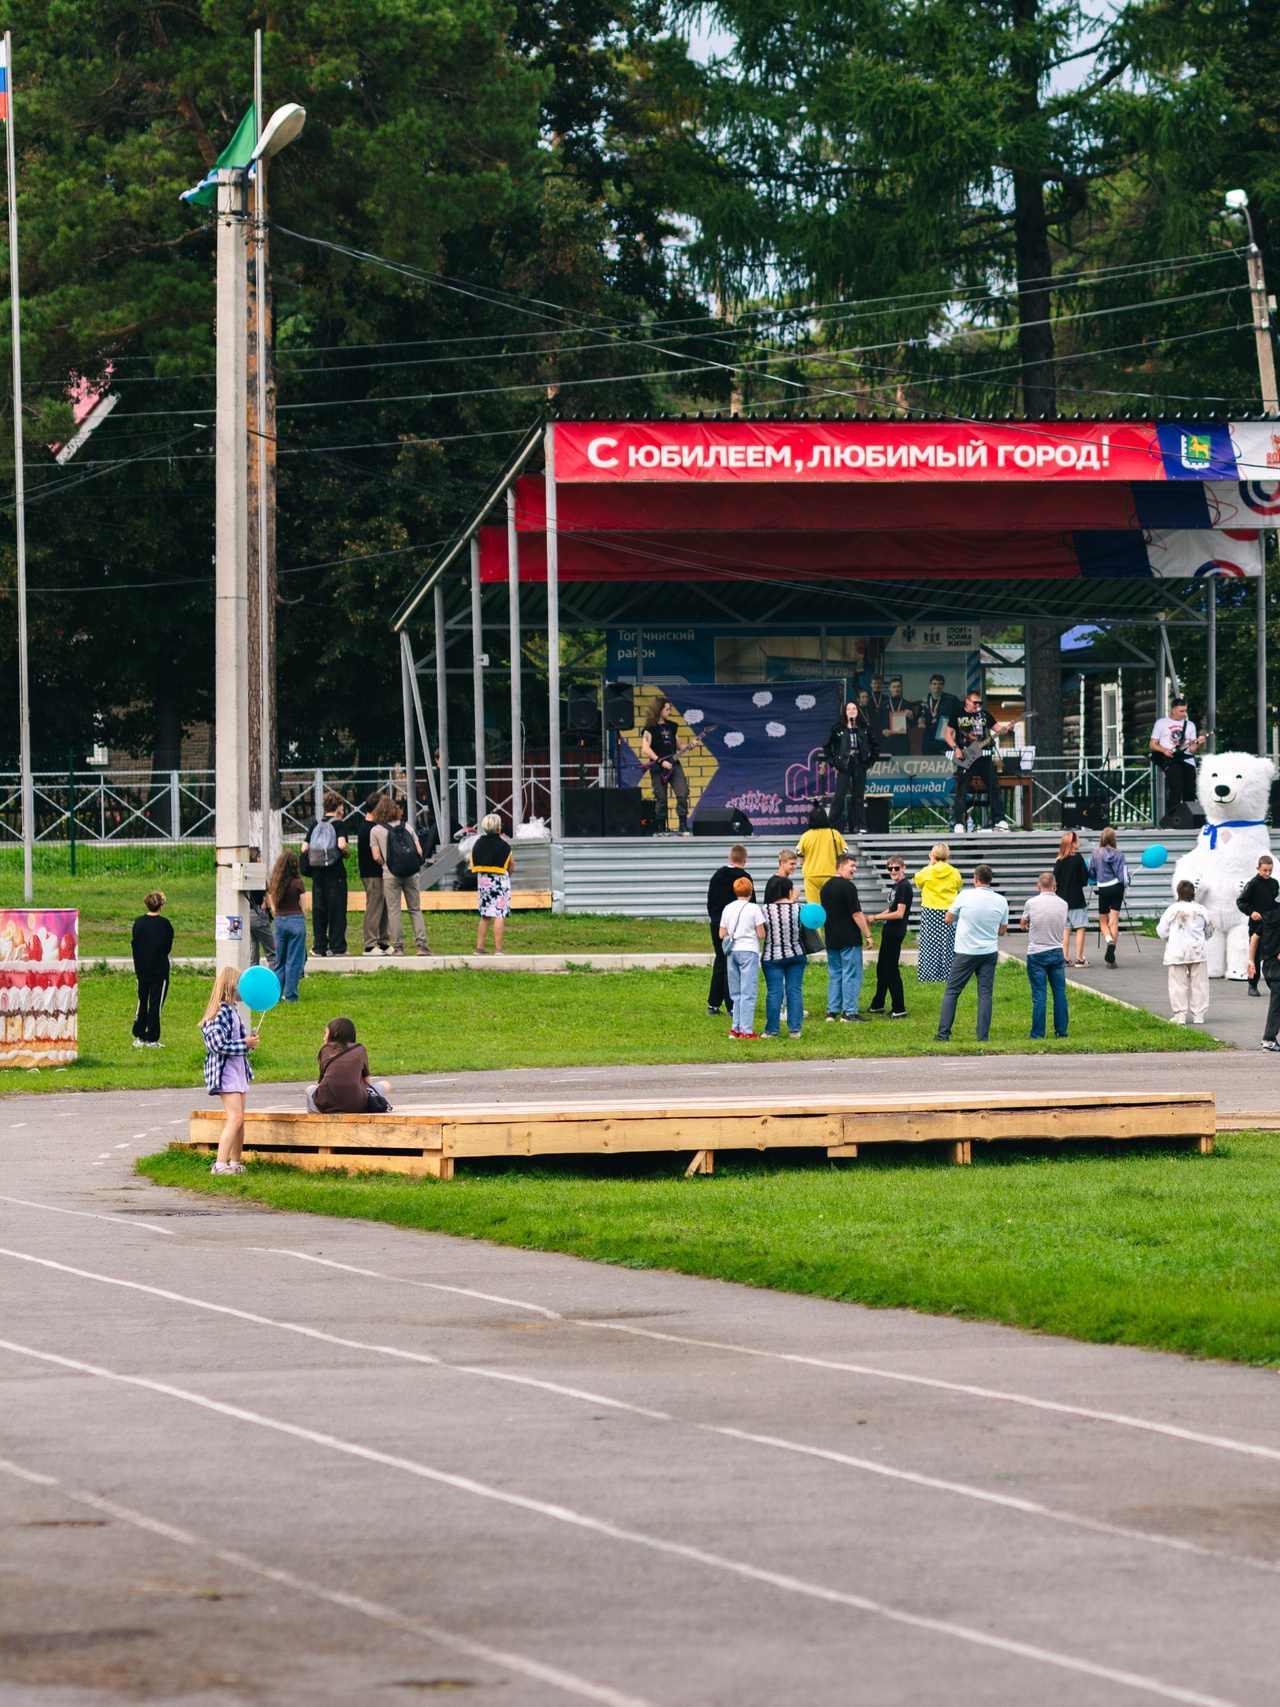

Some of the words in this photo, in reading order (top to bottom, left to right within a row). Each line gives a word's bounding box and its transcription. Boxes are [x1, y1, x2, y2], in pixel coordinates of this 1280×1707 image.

[587, 436, 619, 468] С
[628, 444, 803, 474] ЮБИЛЕЕМ,
[806, 440, 987, 468] ЛЮБИМЫЙ
[997, 435, 1110, 470] ГОРОД!
[616, 629, 695, 641] Тогчинский
[893, 780, 946, 793] команда!
